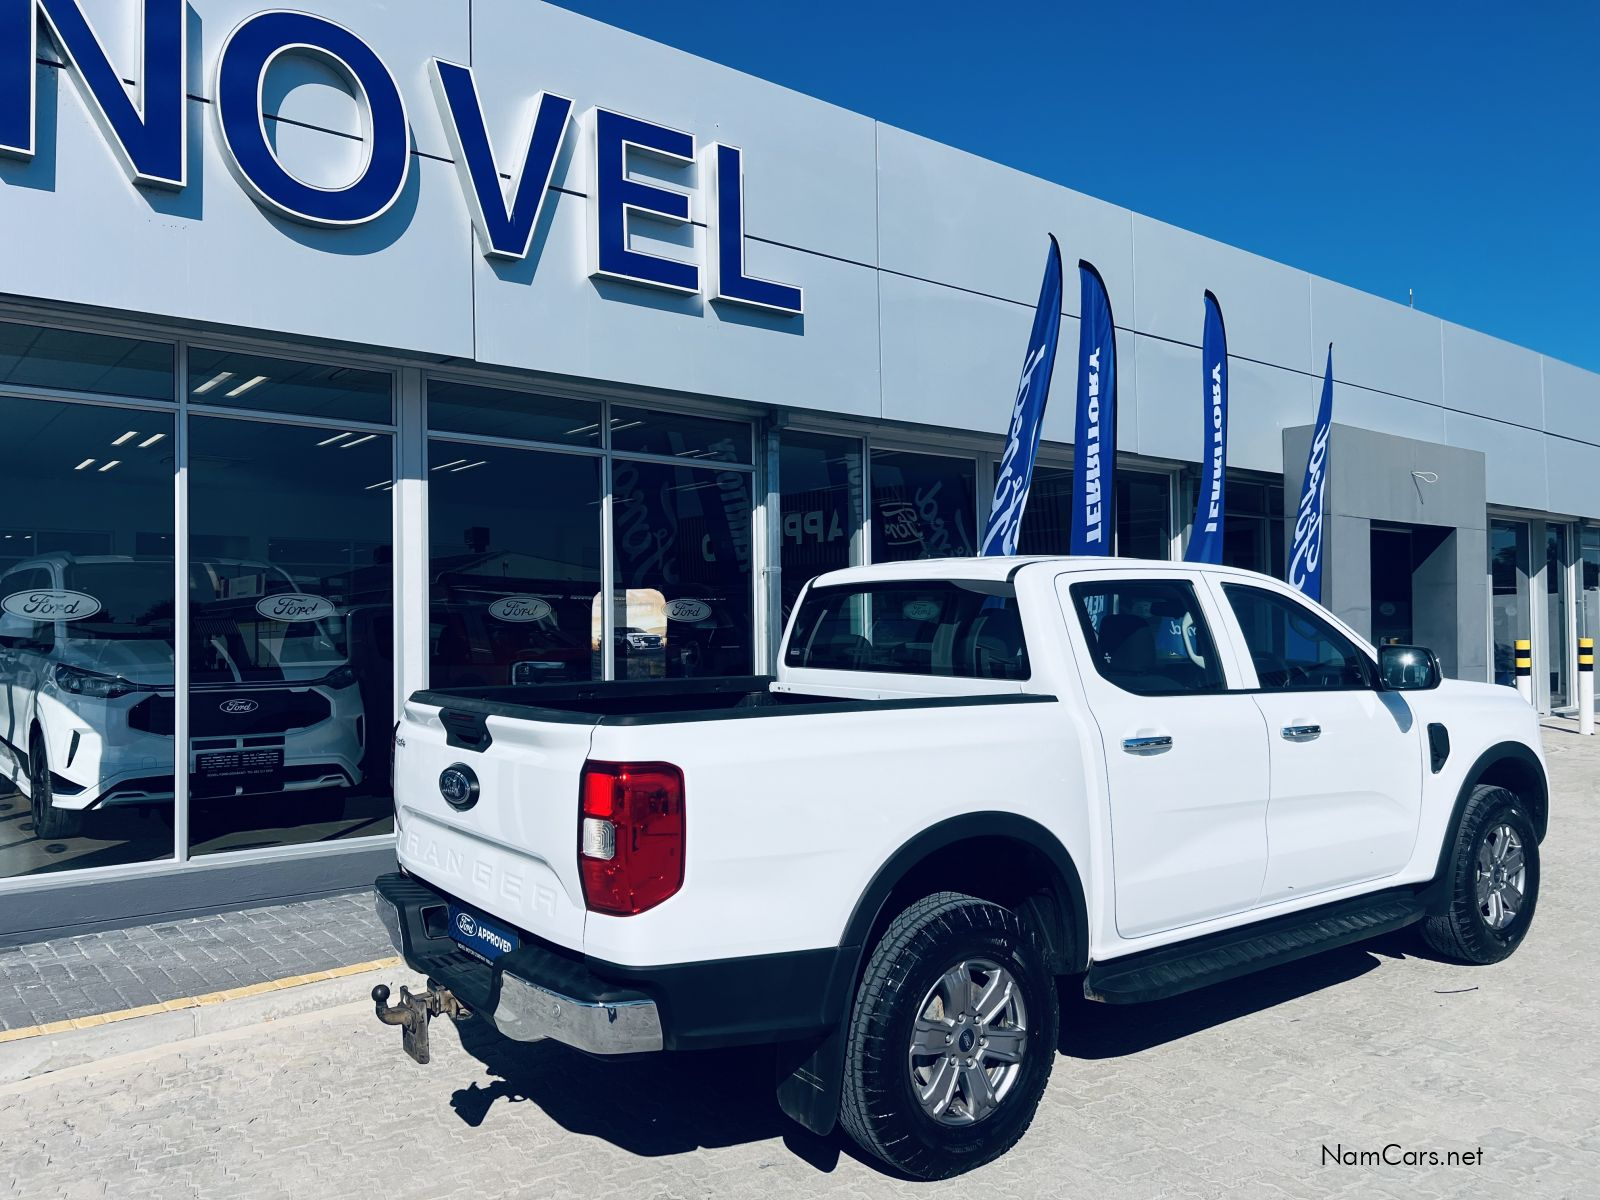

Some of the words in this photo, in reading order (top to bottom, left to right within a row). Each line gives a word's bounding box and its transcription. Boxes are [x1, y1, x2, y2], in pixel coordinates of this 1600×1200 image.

[0, 0, 803, 316] NOVEL
[23, 594, 79, 615] Ford
[273, 597, 318, 617] Ford
[405, 830, 558, 917] RANGER
[477, 926, 512, 952] APPROVED
